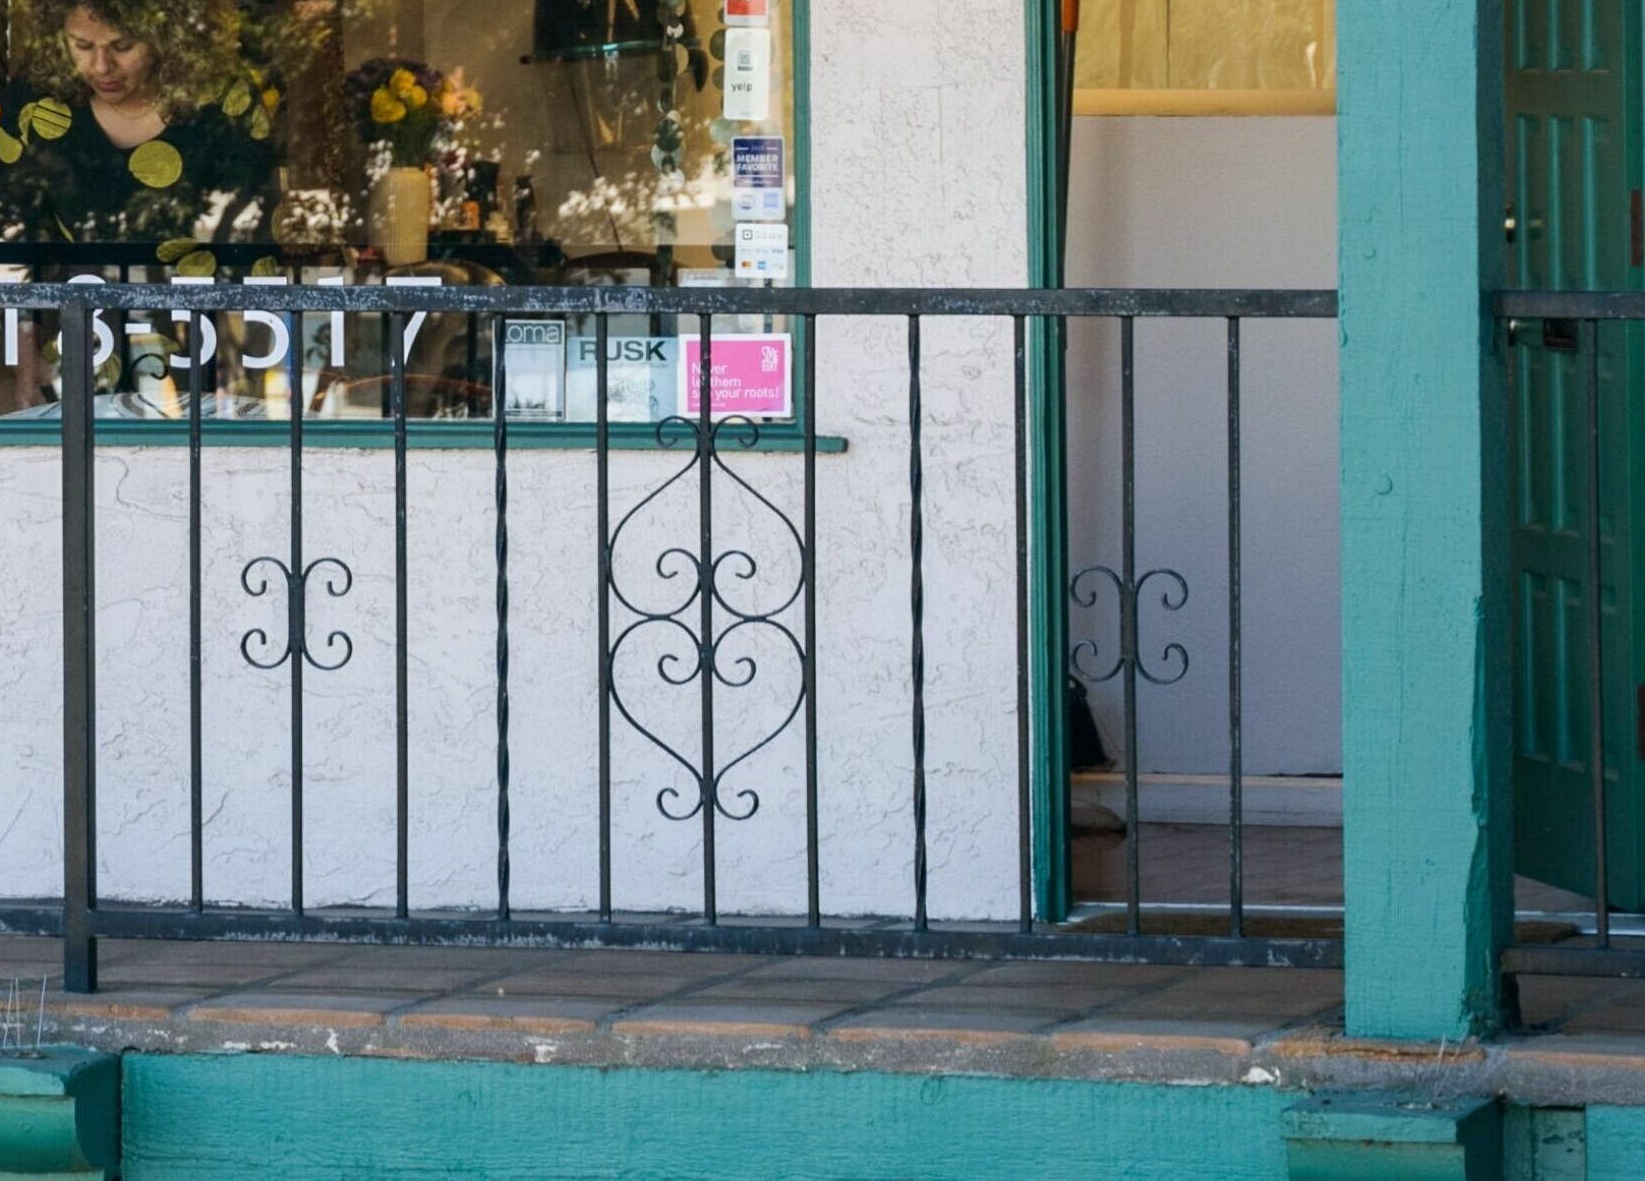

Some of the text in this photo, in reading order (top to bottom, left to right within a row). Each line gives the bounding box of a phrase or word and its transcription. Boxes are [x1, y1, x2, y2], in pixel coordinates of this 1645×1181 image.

[731, 82, 753, 93] yelp
[737, 154, 779, 163] MEMBER
[737, 163, 779, 171] FAVORITE
[505, 324, 560, 343] oma
[580, 339, 667, 361] RUSK
[692, 363, 728, 374] Nver
[715, 388, 741, 400] your
[744, 387, 779, 399] roots!
